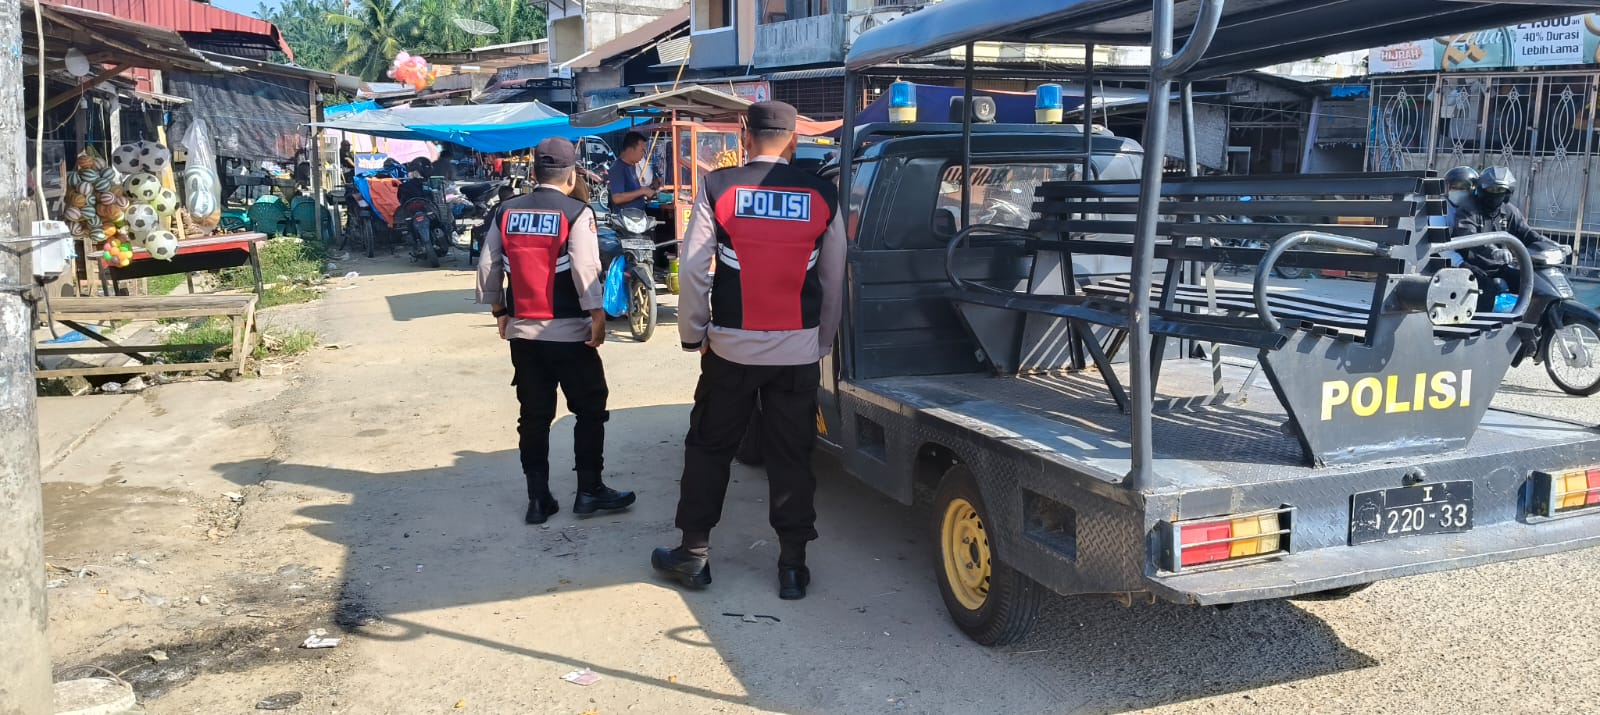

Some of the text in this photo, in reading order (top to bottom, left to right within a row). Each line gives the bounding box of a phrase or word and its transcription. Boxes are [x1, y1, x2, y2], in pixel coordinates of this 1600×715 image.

[1522, 30, 1579, 42] 40% Durasi
[1381, 49, 1420, 60] HIJRAH
[1522, 45, 1548, 56] Lebih
[738, 190, 809, 219] POLISI
[509, 213, 558, 233] POLISI
[1320, 369, 1473, 421] POLISI
[1423, 487, 1433, 501] I
